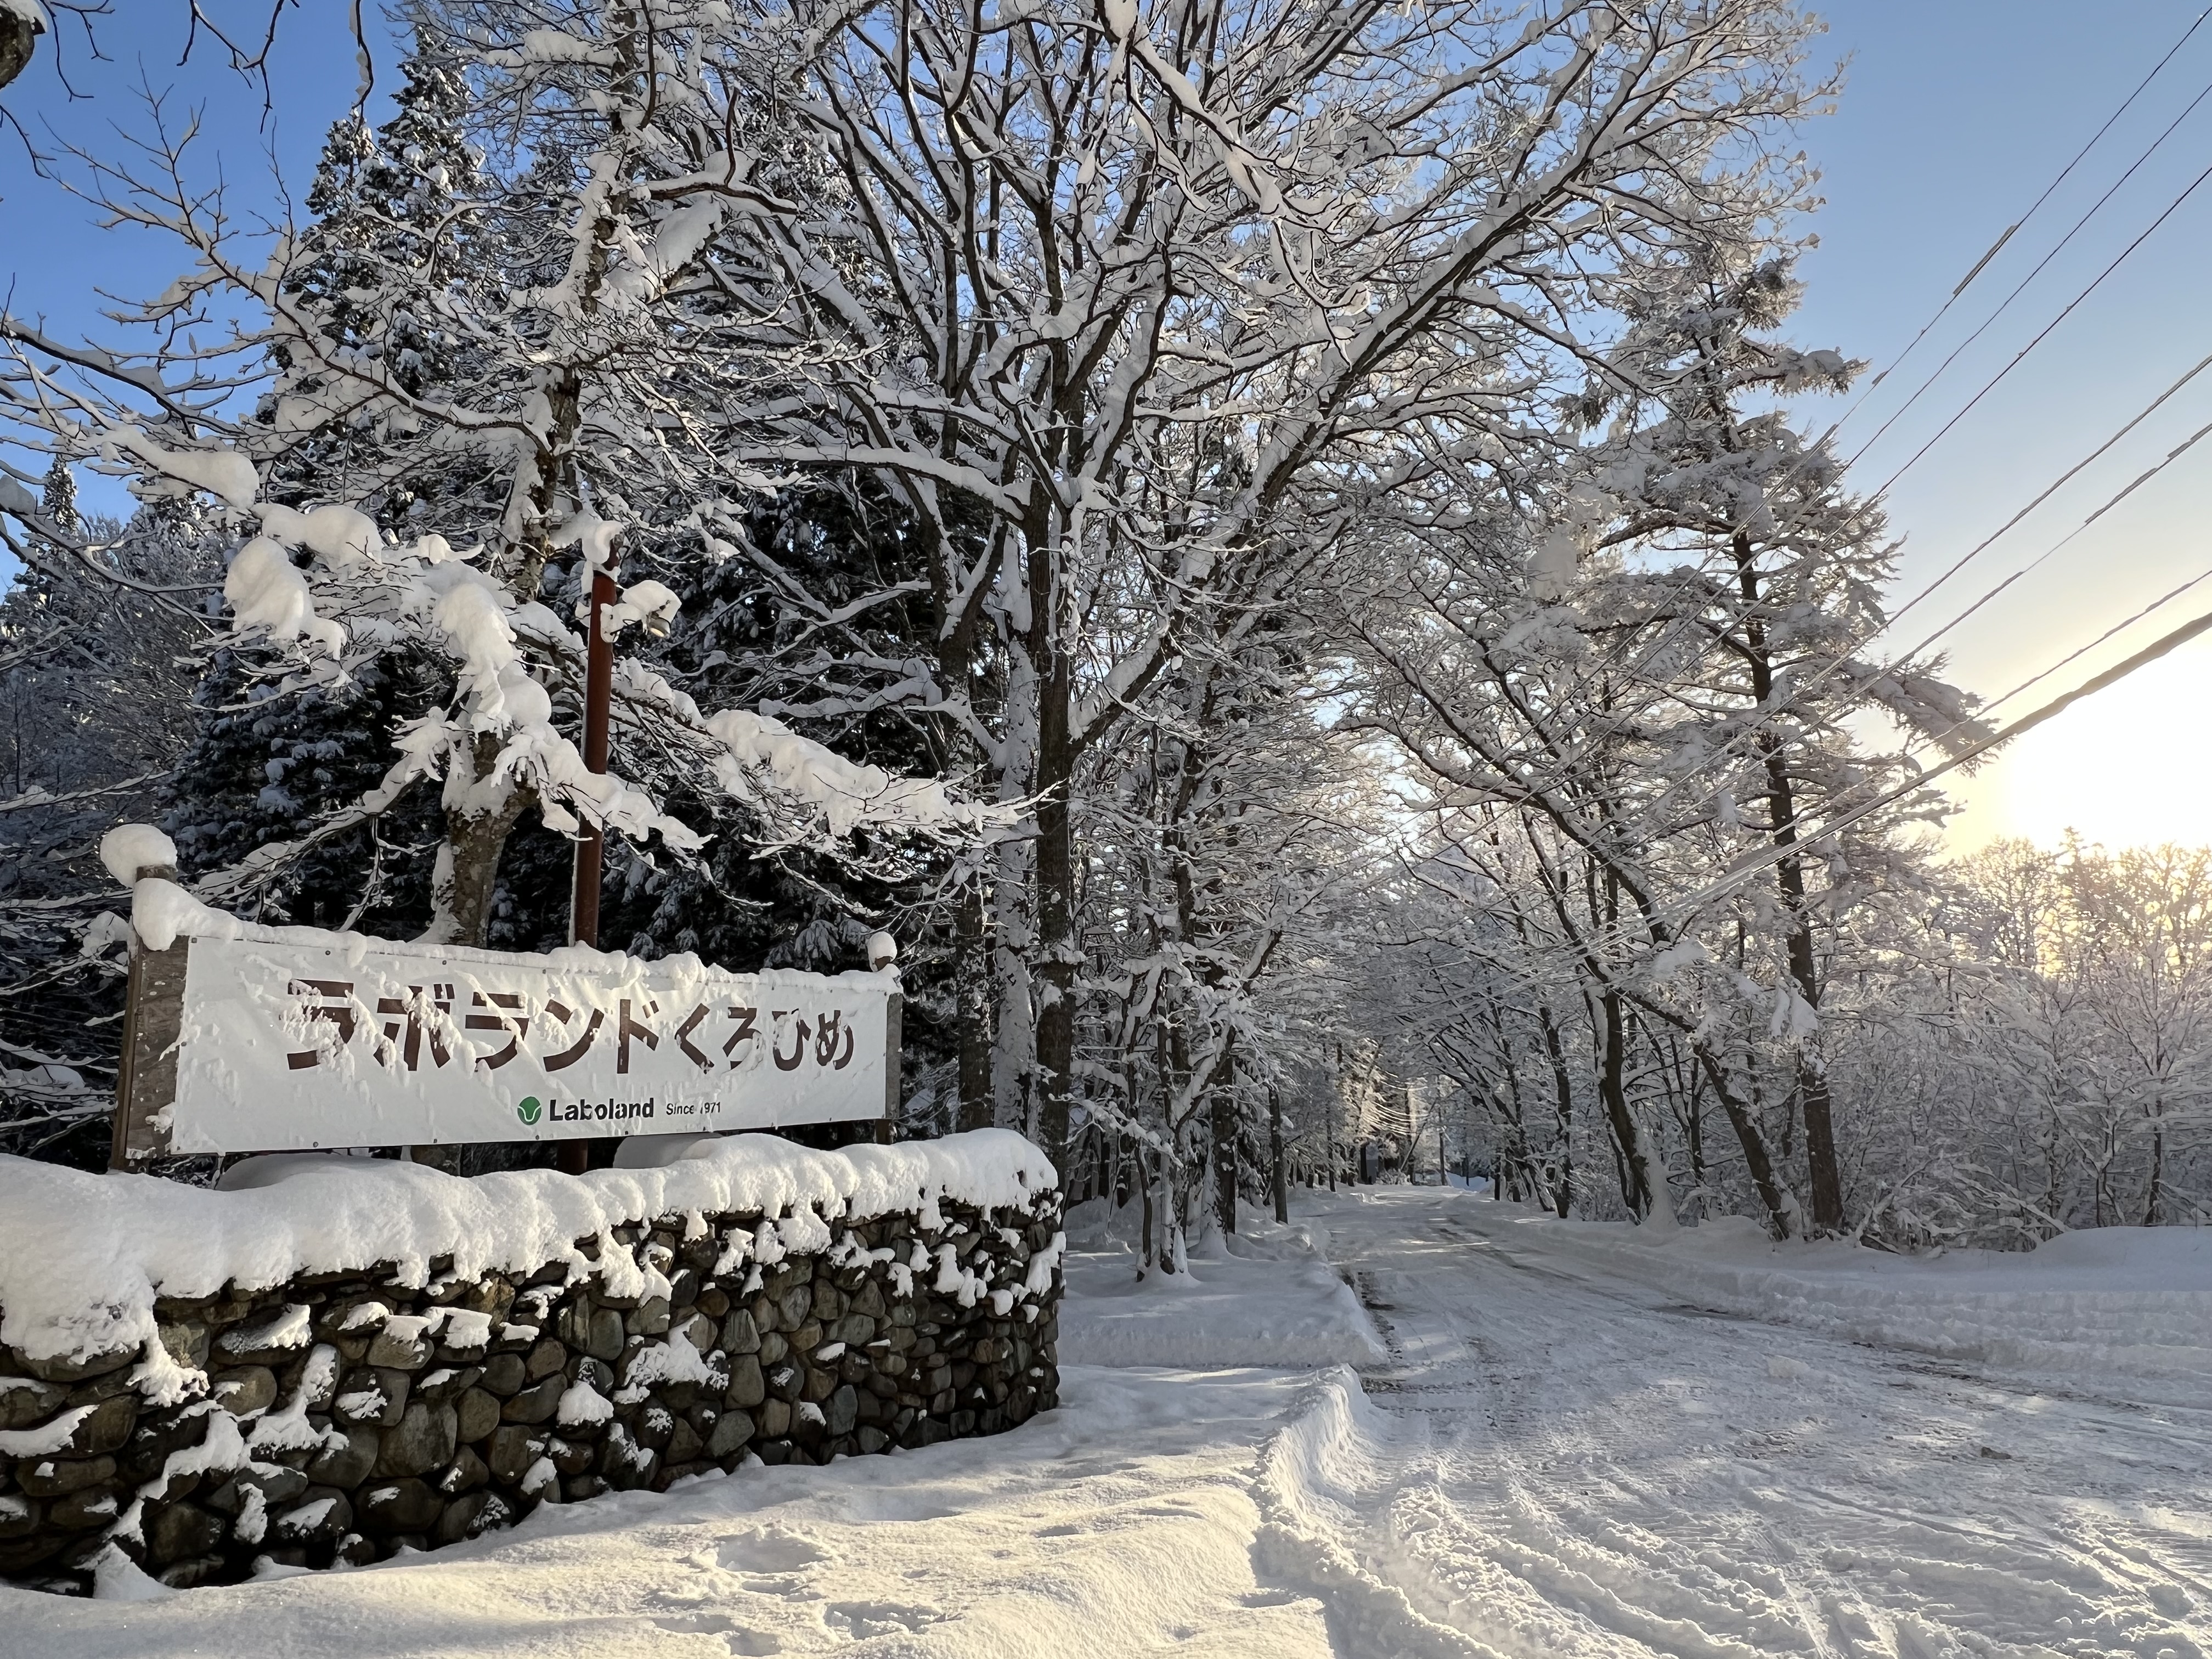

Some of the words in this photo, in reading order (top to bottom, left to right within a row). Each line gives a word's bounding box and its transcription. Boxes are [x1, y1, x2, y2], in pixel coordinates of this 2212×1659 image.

[279, 978, 854, 1074] ラボランドくろひめ
[550, 1098, 654, 1121] Laboland
[666, 1103, 695, 1115] Since
